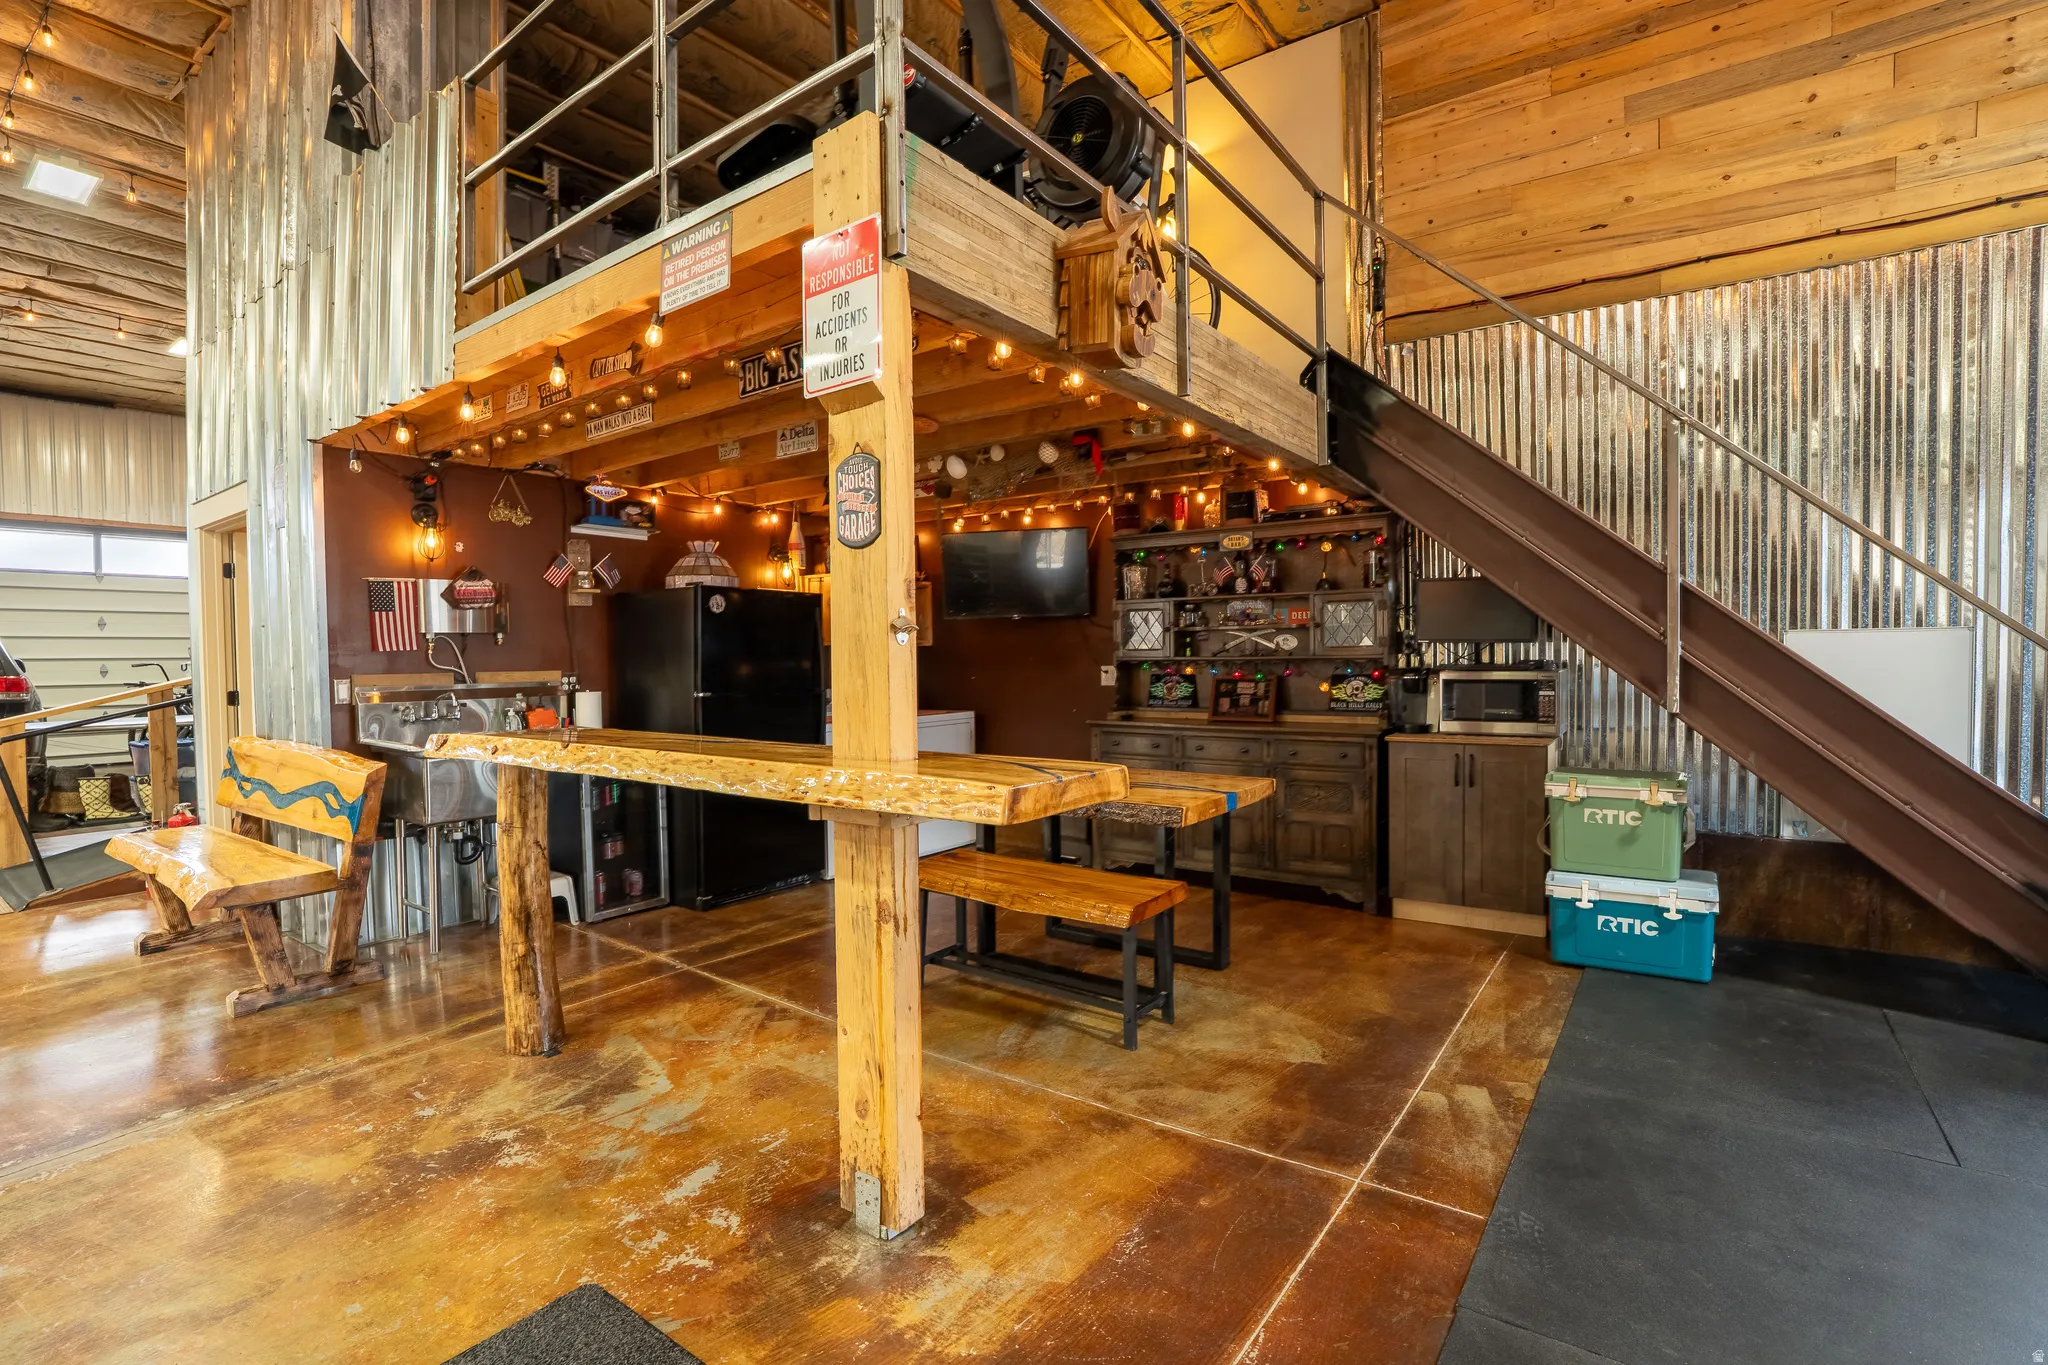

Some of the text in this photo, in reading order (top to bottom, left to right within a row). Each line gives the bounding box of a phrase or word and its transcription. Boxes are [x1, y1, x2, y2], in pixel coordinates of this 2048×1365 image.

[672, 221, 720, 255] WARNING
[832, 238, 851, 262] NOT
[664, 252, 727, 287] ON THE PREMISES
[665, 239, 726, 275] RETIRED PERSON
[664, 269, 725, 299] KNOWS EVERYTHING AND HAS
[809, 253, 874, 294] RESPONSIBLE
[666, 298, 680, 307] PLENTY
[682, 293, 688, 301] OF
[689, 289, 698, 299] TIME
[706, 281, 716, 291] TELL
[832, 290, 850, 312] FOR
[815, 306, 868, 340] ACCIDENTS
[835, 335, 848, 353] OR
[745, 358, 769, 392] BIG
[820, 352, 865, 382] INJURIES
[544, 390, 567, 405] AT WORK
[594, 420, 604, 434] MAN
[604, 413, 620, 431] WALKS
[621, 411, 632, 426] INTO
[637, 406, 648, 421] BAR
[789, 425, 815, 440] Delta
[779, 438, 815, 454] Air Lines
[837, 466, 875, 494] CHOICES
[844, 462, 869, 474] TOUGH
[839, 512, 876, 540] GARAGE
[1584, 807, 1642, 826] RTIC
[1597, 915, 1659, 937] RTIC
